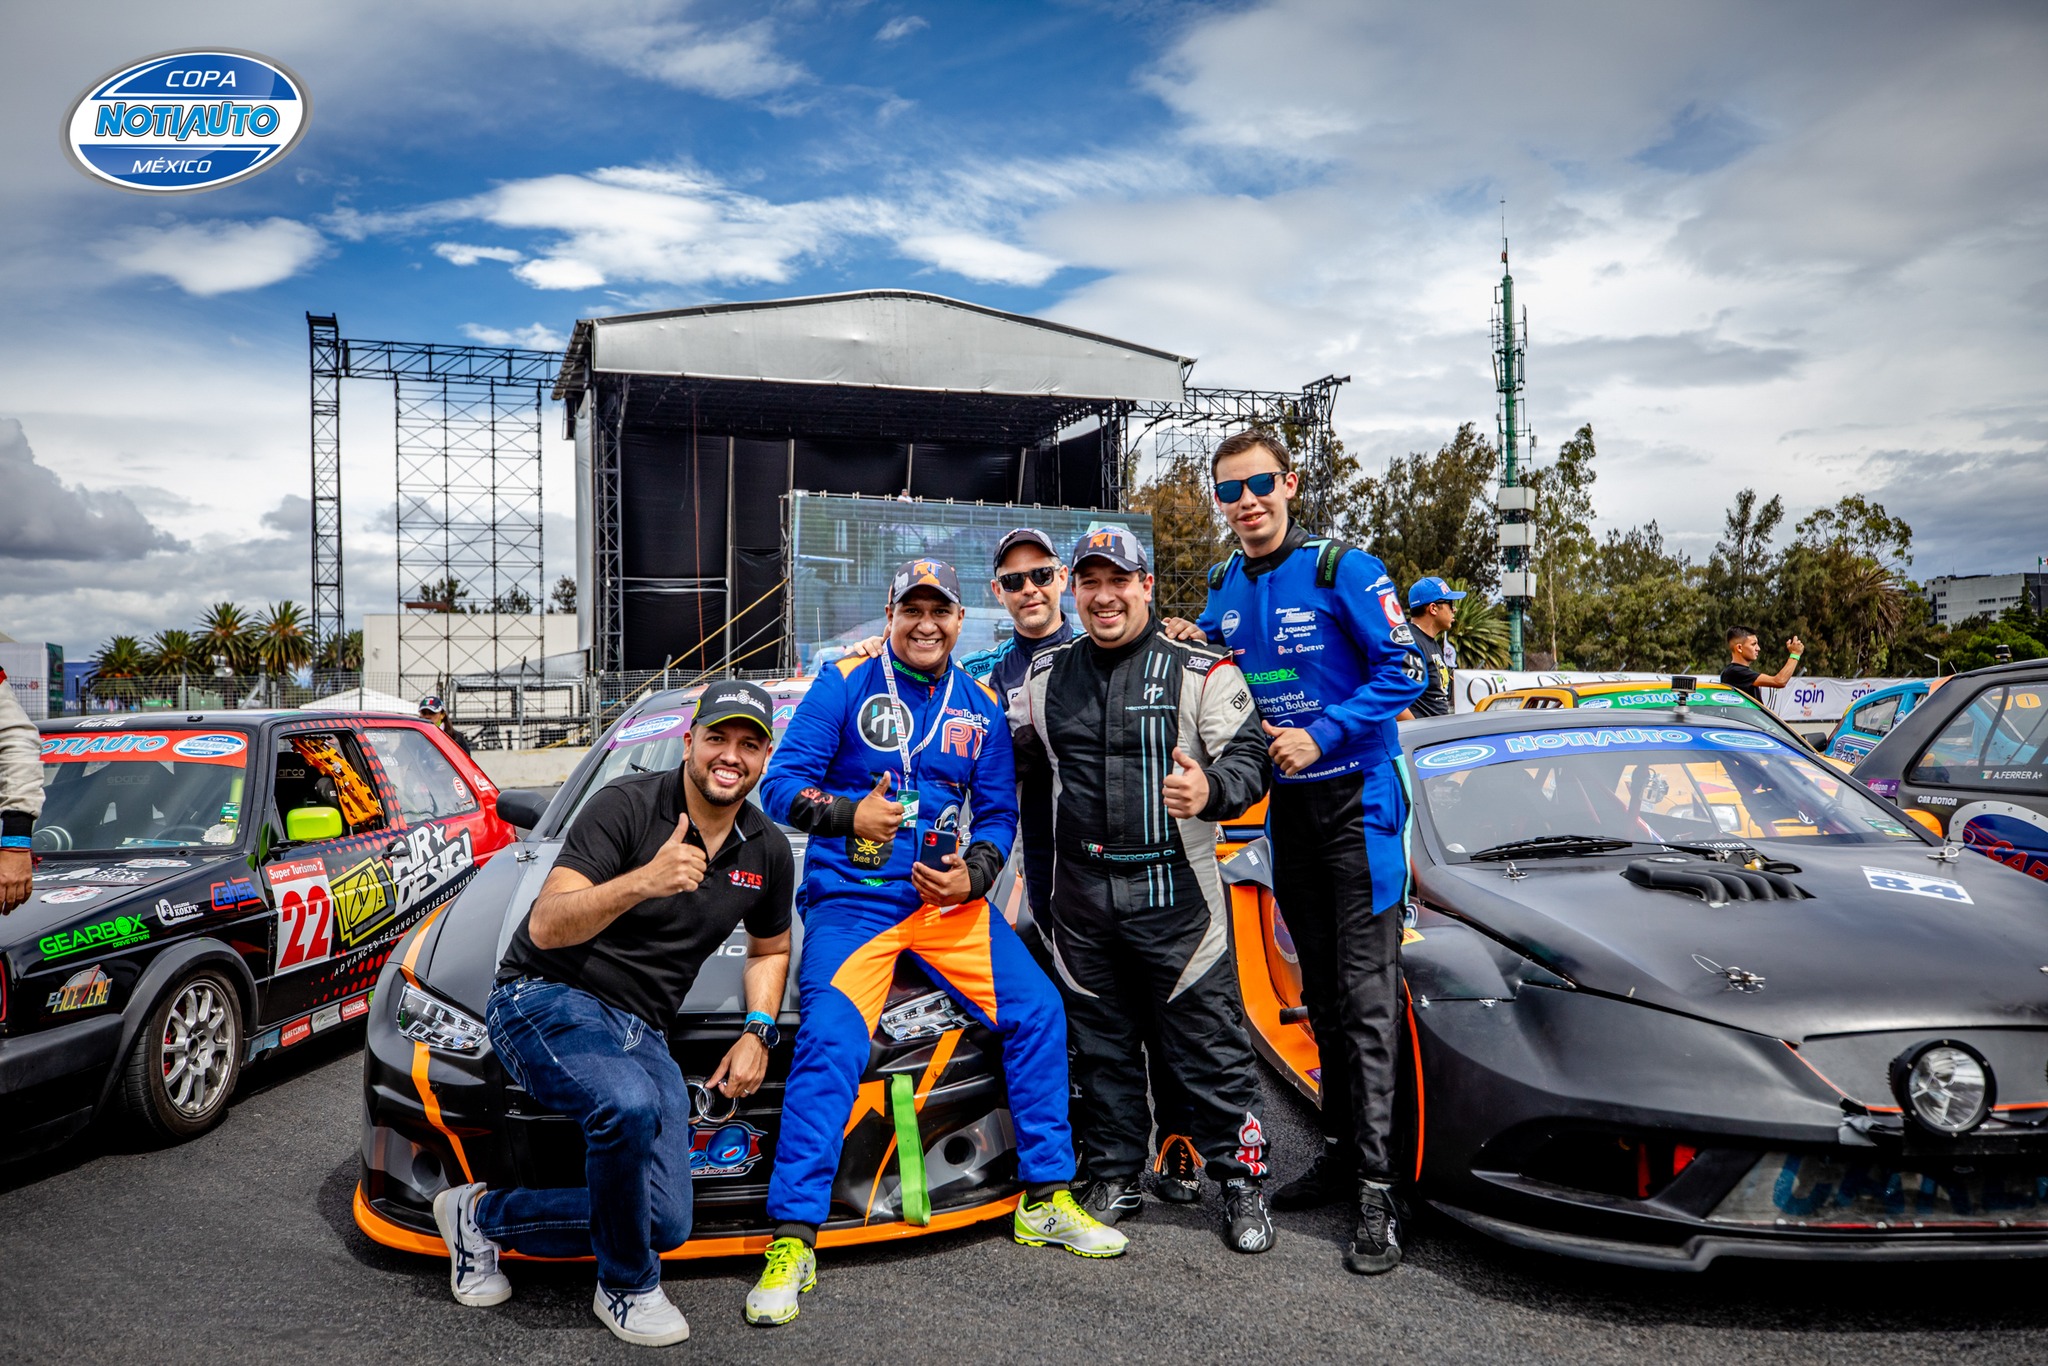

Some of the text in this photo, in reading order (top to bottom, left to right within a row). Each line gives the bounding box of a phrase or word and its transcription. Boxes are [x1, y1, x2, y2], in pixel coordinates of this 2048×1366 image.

[970, 663, 991, 675] OMP
[1188, 657, 1211, 669] OMP
[1232, 690, 1248, 710] OMP
[1617, 693, 1706, 706] NOTIAO
[1794, 685, 1825, 707] spin
[41, 733, 169, 757] OTIAUTO
[1505, 726, 1693, 754] NOTIAUTO
[278, 768, 306, 777] arco
[269, 861, 324, 882] Super Turismo 2
[1870, 875, 1966, 901] 84
[39, 914, 148, 955] GEARBOX
[278, 885, 331, 970] 22
[334, 940, 379, 977] ADVANCED
[379, 903, 431, 944] TECHNOLOGY
